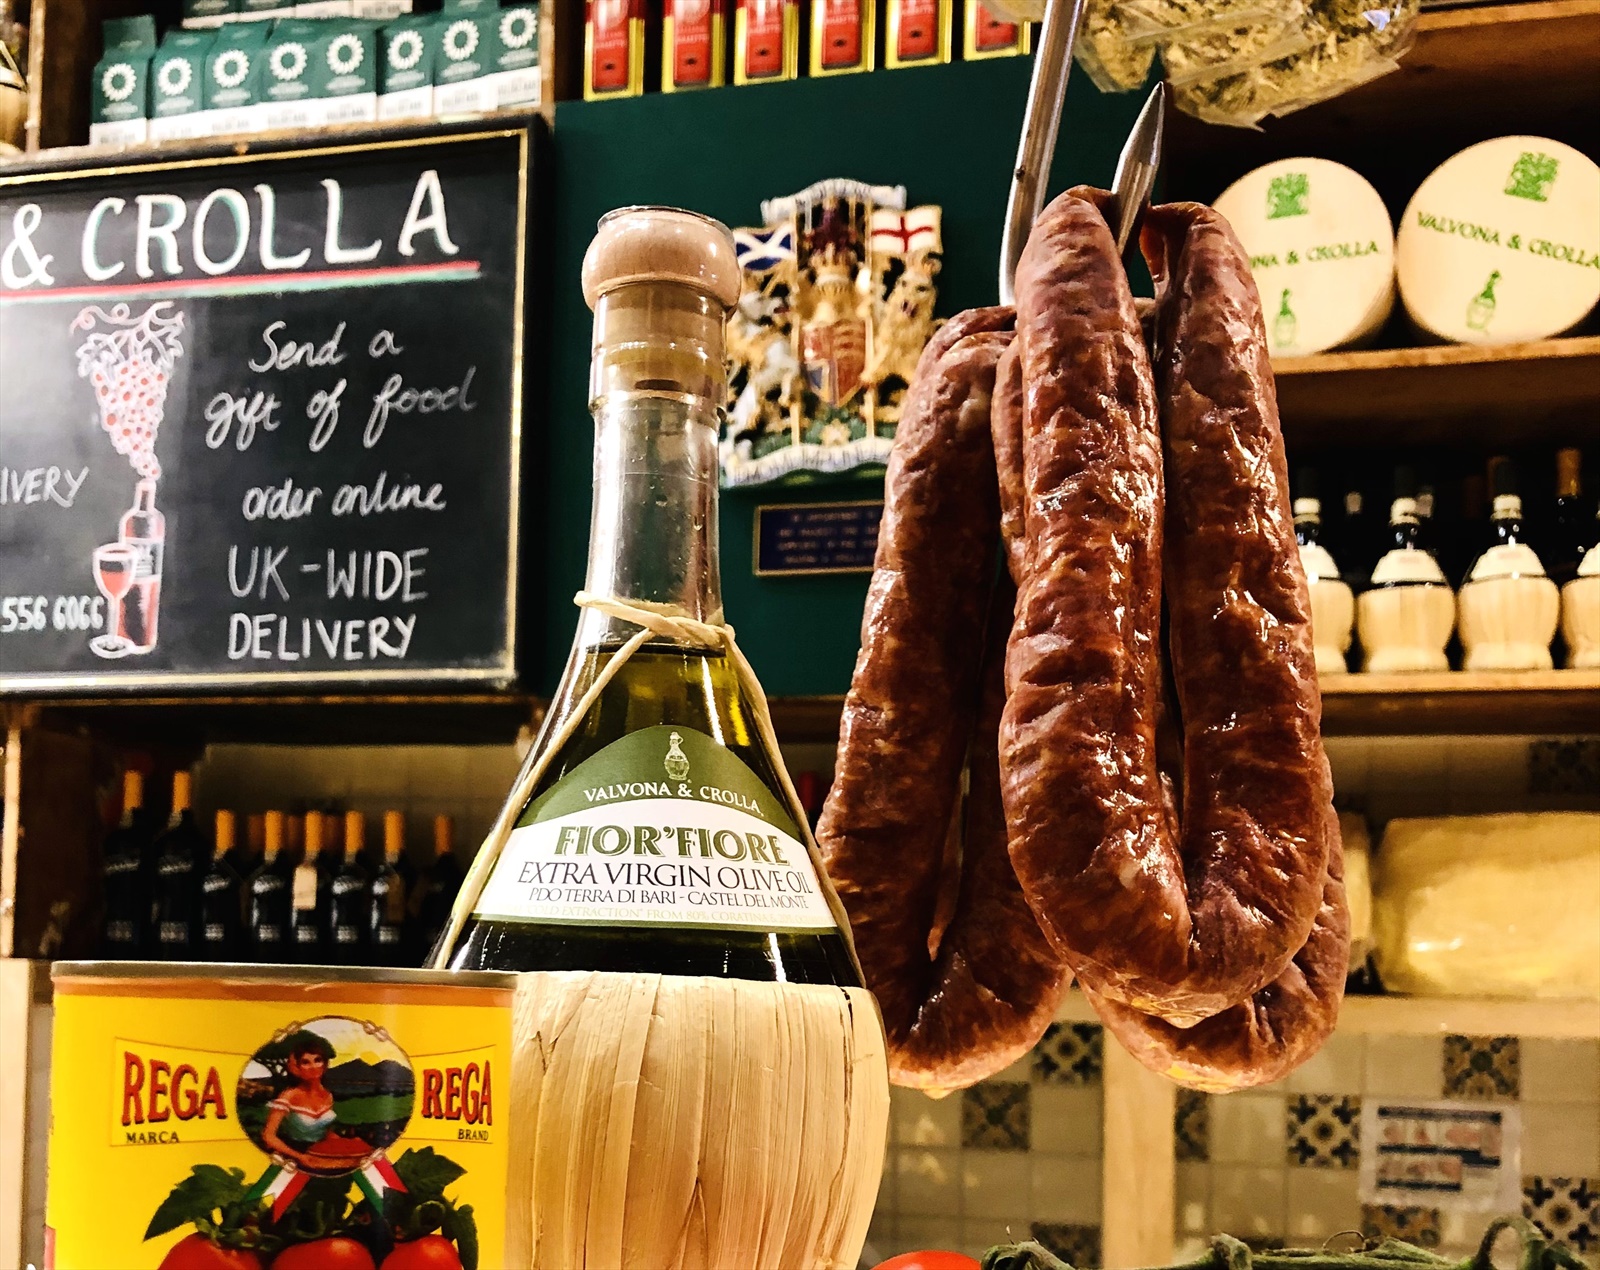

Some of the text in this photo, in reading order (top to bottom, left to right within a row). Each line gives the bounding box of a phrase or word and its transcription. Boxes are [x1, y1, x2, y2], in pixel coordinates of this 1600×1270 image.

[2, 169, 460, 289] & CROLLA
[1416, 210, 1600, 269] VALVONA & CROLLA
[1285, 250, 1299, 265] &
[1305, 240, 1378, 262] CROLLA
[248, 319, 404, 373] Send a
[203, 364, 477, 452] gift of food
[242, 470, 447, 521] order online
[0, 595, 105, 633] 556 6066
[228, 612, 417, 660] DELIVERY
[583, 782, 761, 814] VALVONA & CROLLA
[553, 825, 791, 867] FIOR'FIORE
[517, 861, 814, 894] EXTRA VIRGIN OLIVE OIL
[528, 887, 563, 902] PDO
[564, 888, 614, 904] TERRA
[617, 889, 637, 904] DI
[640, 890, 677, 905] BARI
[687, 891, 743, 907] CASTEL
[744, 894, 770, 908] DEL
[769, 894, 809, 910] MONTE
[646, 908, 684, 920] FROM
[122, 1051, 228, 1127] REGA
[421, 1060, 492, 1126] REGA
[126, 1131, 180, 1144] MARCA
[458, 1128, 489, 1141] BRAND
